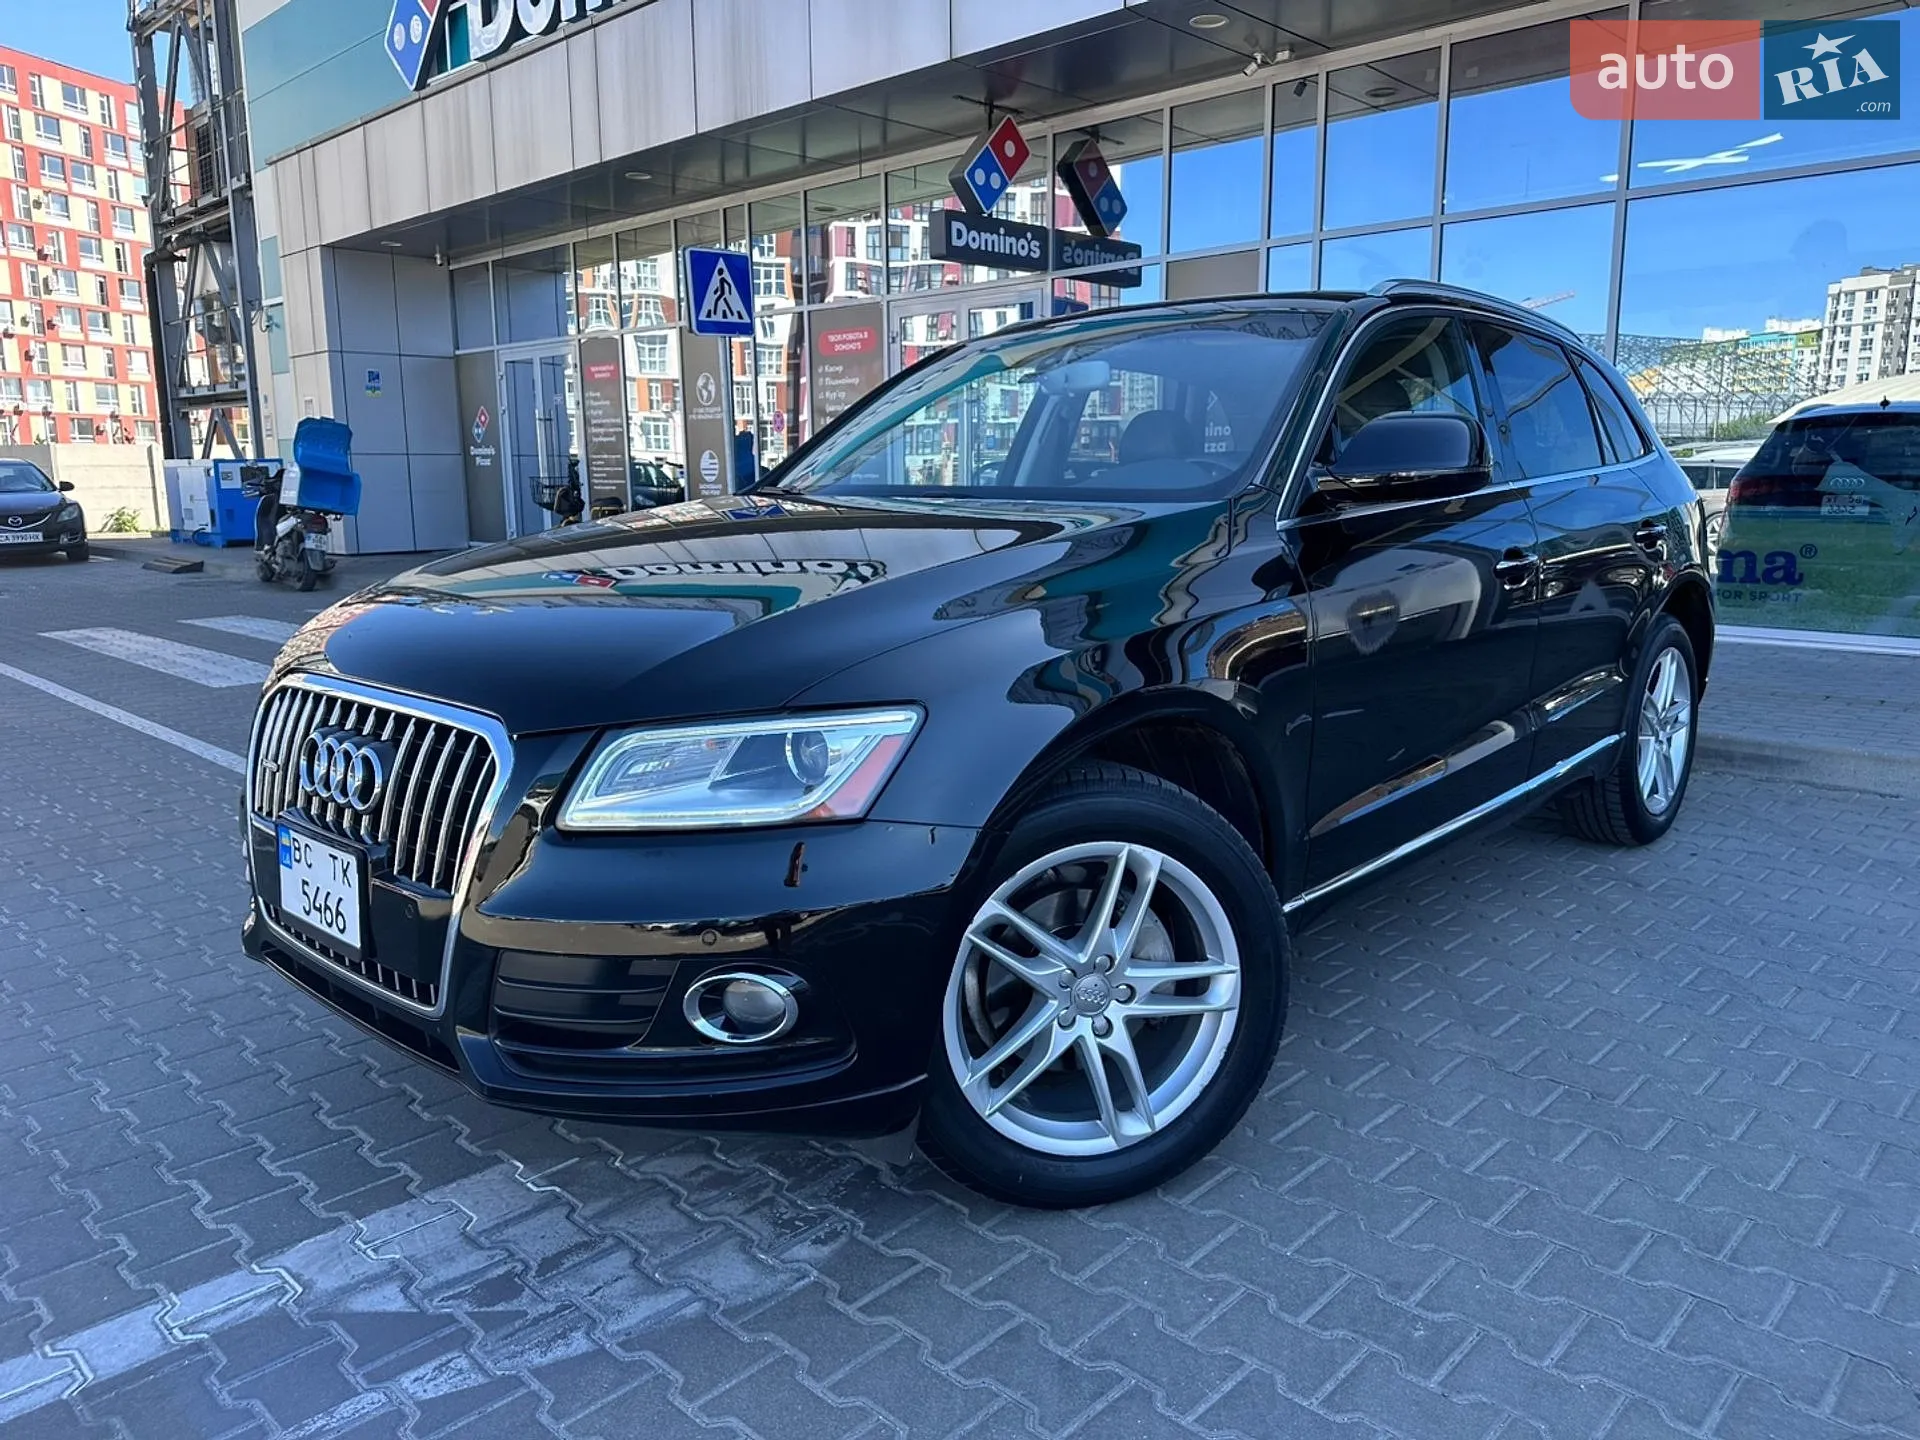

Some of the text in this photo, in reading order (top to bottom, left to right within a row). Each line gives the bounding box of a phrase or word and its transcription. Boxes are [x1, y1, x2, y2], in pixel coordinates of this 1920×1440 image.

[950, 221, 1041, 259] Domino's
[1749, 589, 1803, 603] SPORT
[292, 836, 352, 889] BC TK
[302, 878, 347, 935] 5466
